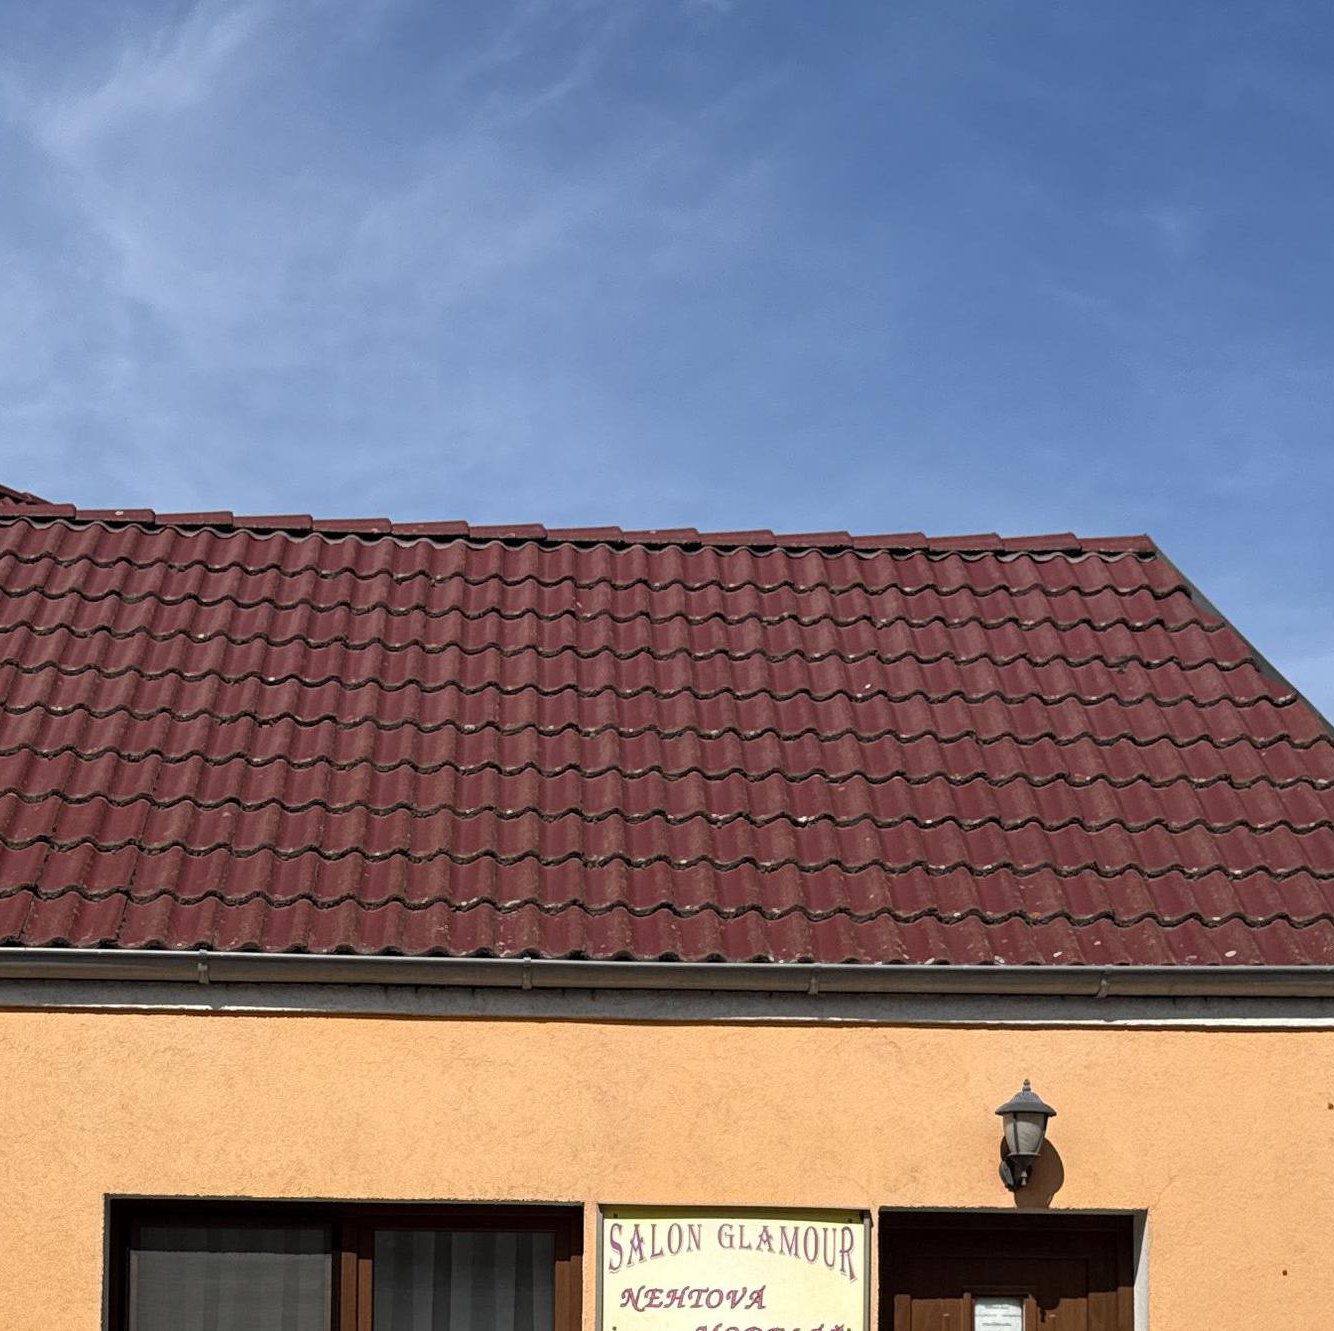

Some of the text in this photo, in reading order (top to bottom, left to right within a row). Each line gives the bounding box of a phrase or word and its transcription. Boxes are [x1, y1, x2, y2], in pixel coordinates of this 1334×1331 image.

[608, 1222, 857, 1281] SALON GLAMOUR
[619, 1285, 767, 1312] NEHTOVÁ
